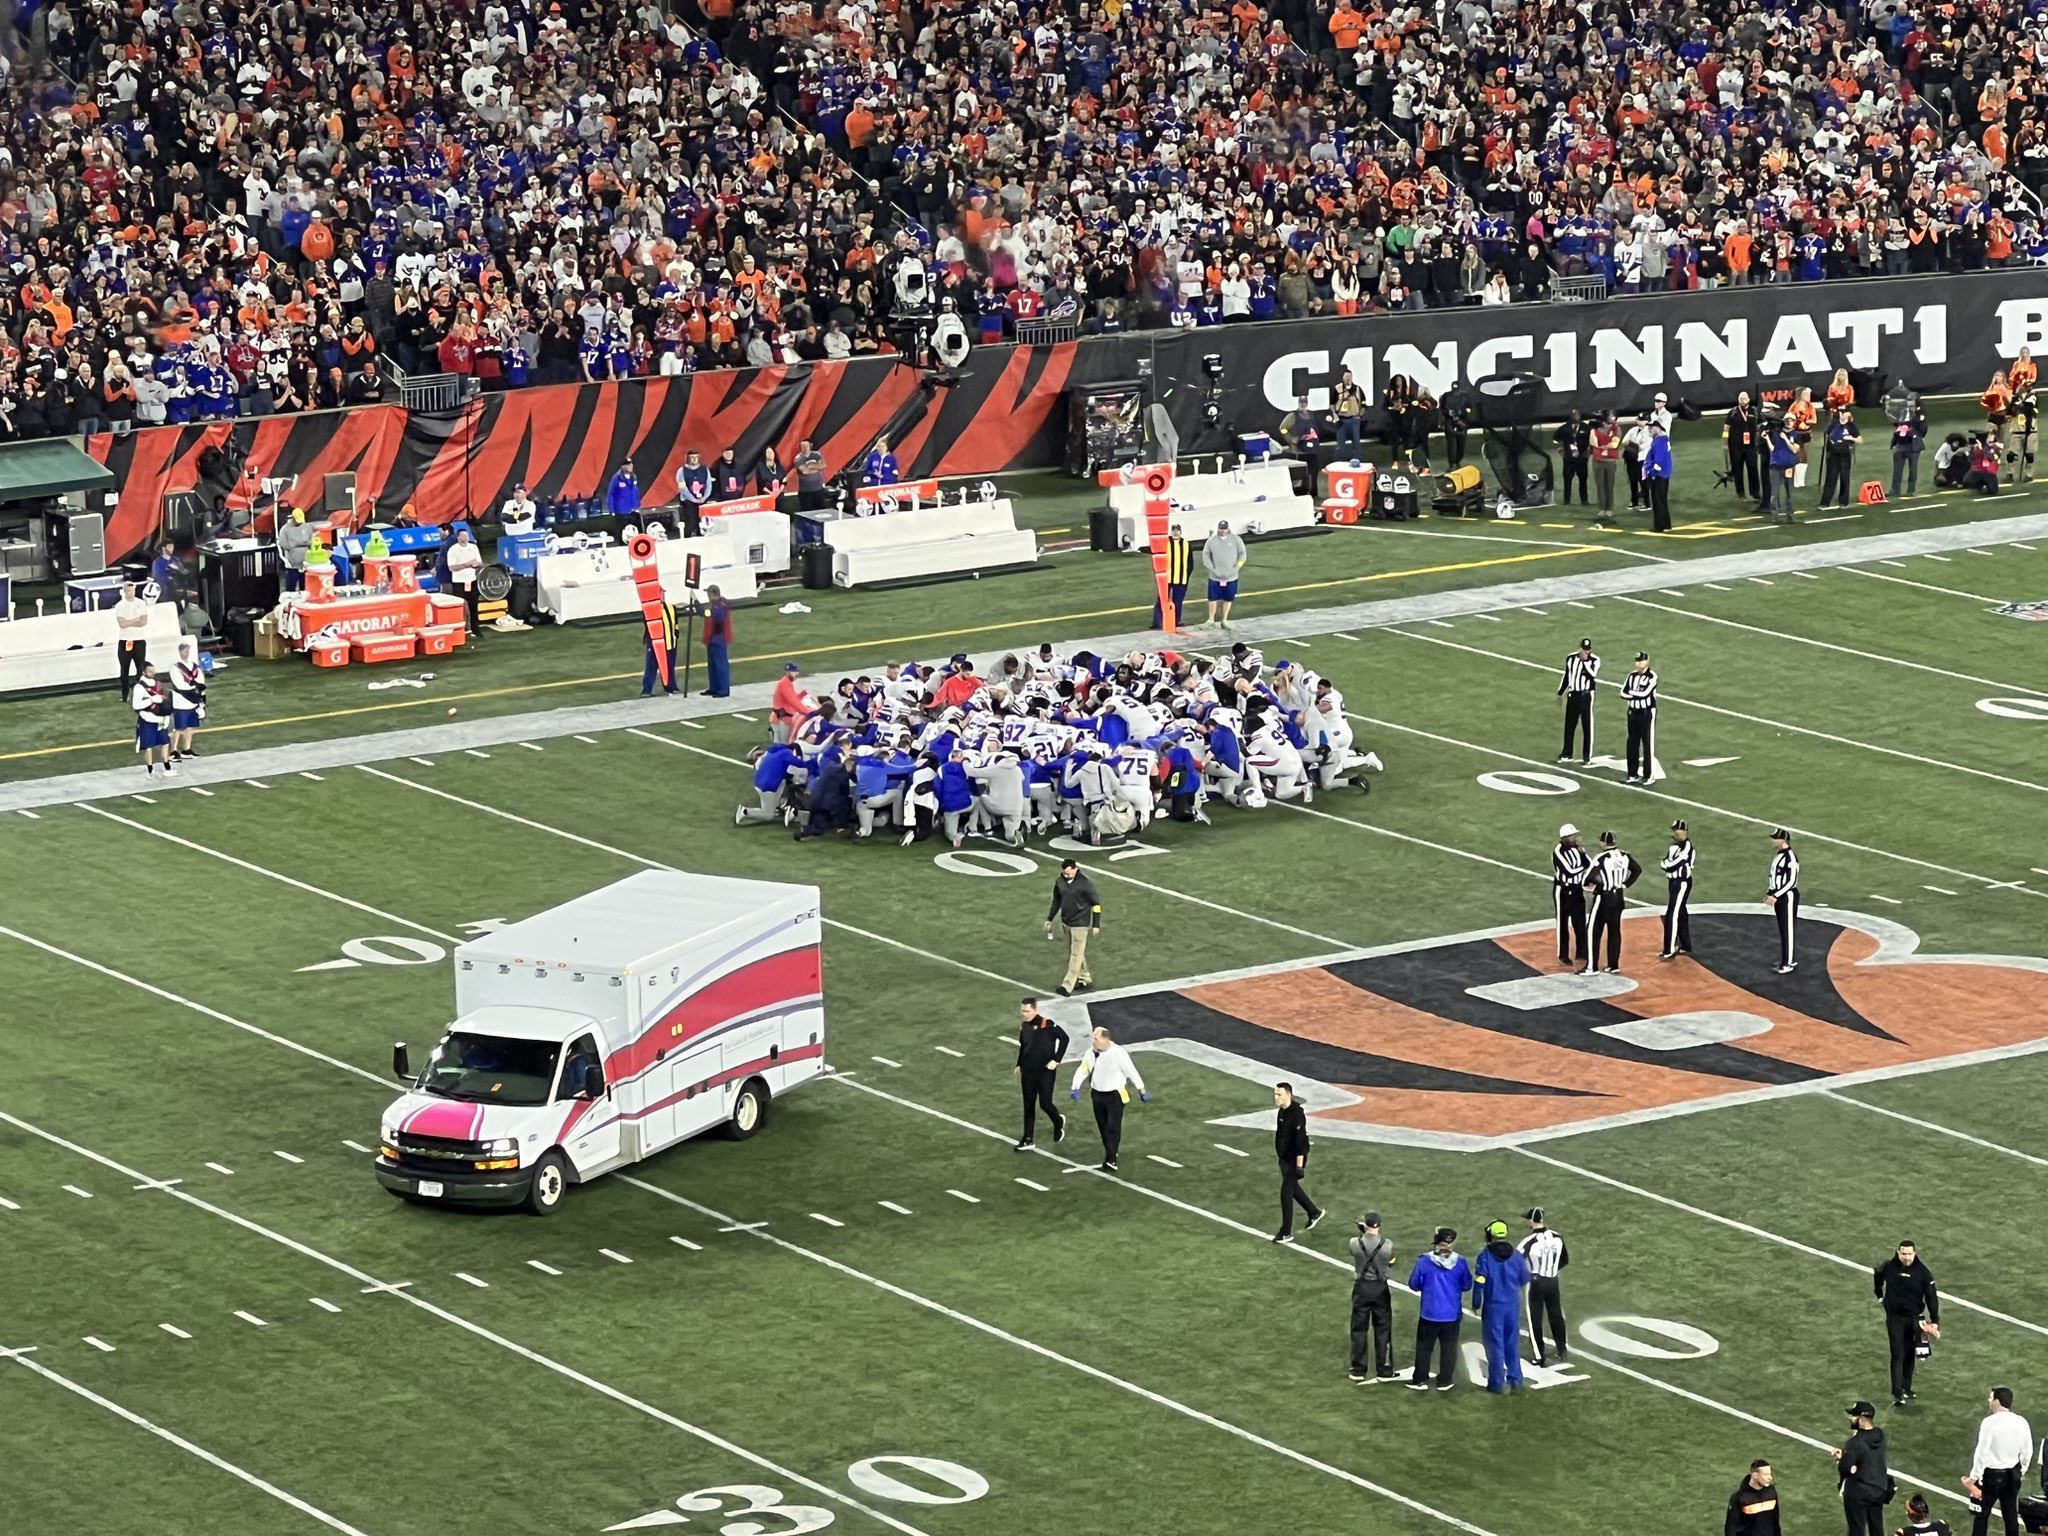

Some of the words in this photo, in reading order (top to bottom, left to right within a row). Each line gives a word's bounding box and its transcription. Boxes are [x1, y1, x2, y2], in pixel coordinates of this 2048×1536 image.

[1930, 53, 1943, 68] 55
[1621, 251, 1632, 264] 17
[1018, 298, 1032, 312] 17
[587, 352, 598, 364] 17
[1263, 304, 1947, 412] CINCINNATI
[1868, 484, 1883, 501] 20
[720, 500, 762, 515] GATORADE
[371, 643, 408, 655] GATORADE
[1004, 724, 1026, 742] 97
[1034, 742, 1057, 760] 21
[1123, 757, 1148, 775] 75
